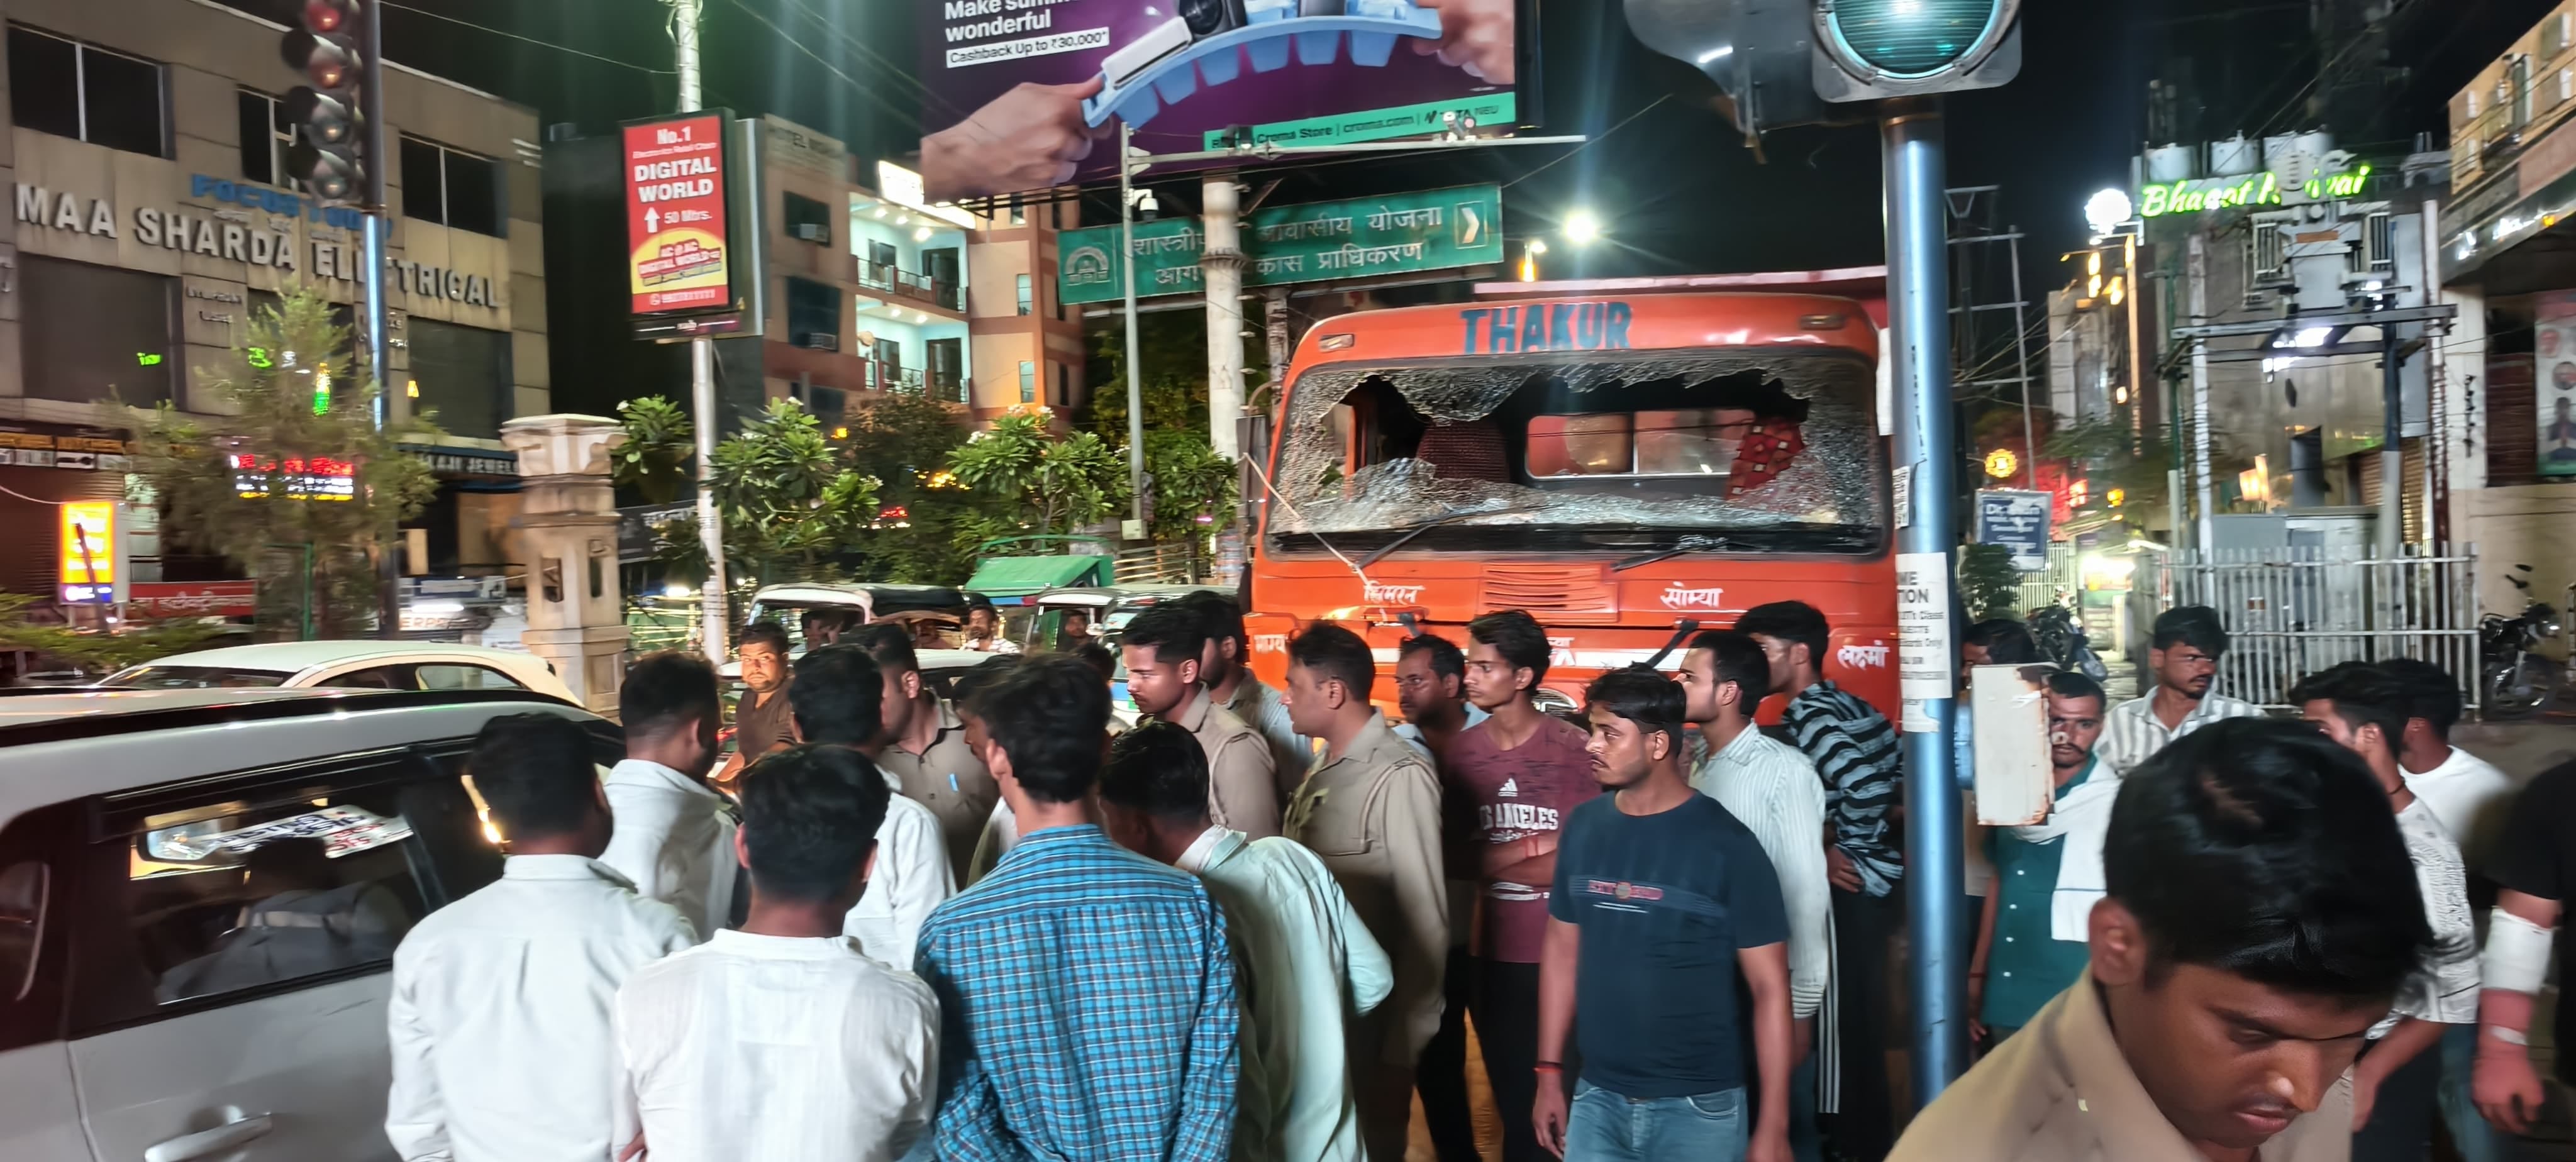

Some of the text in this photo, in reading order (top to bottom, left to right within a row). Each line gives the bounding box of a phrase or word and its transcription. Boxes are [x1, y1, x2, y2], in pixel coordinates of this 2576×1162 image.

[945, 0, 1002, 19] Make
[945, 9, 1052, 42] wonderful
[950, 45, 1013, 64] Cashback
[1016, 43, 1033, 55] Up
[1036, 40, 1048, 51] to
[1299, 127, 1333, 138] Store
[635, 156, 717, 182] DIGITAL
[638, 178, 714, 203] WORLD
[15, 182, 118, 239] MAA
[133, 206, 295, 272] SHARDA
[1365, 205, 1444, 231] योजना
[1318, 242, 1424, 270] प्राधिकरण
[1460, 302, 1631, 356] THAKUR
